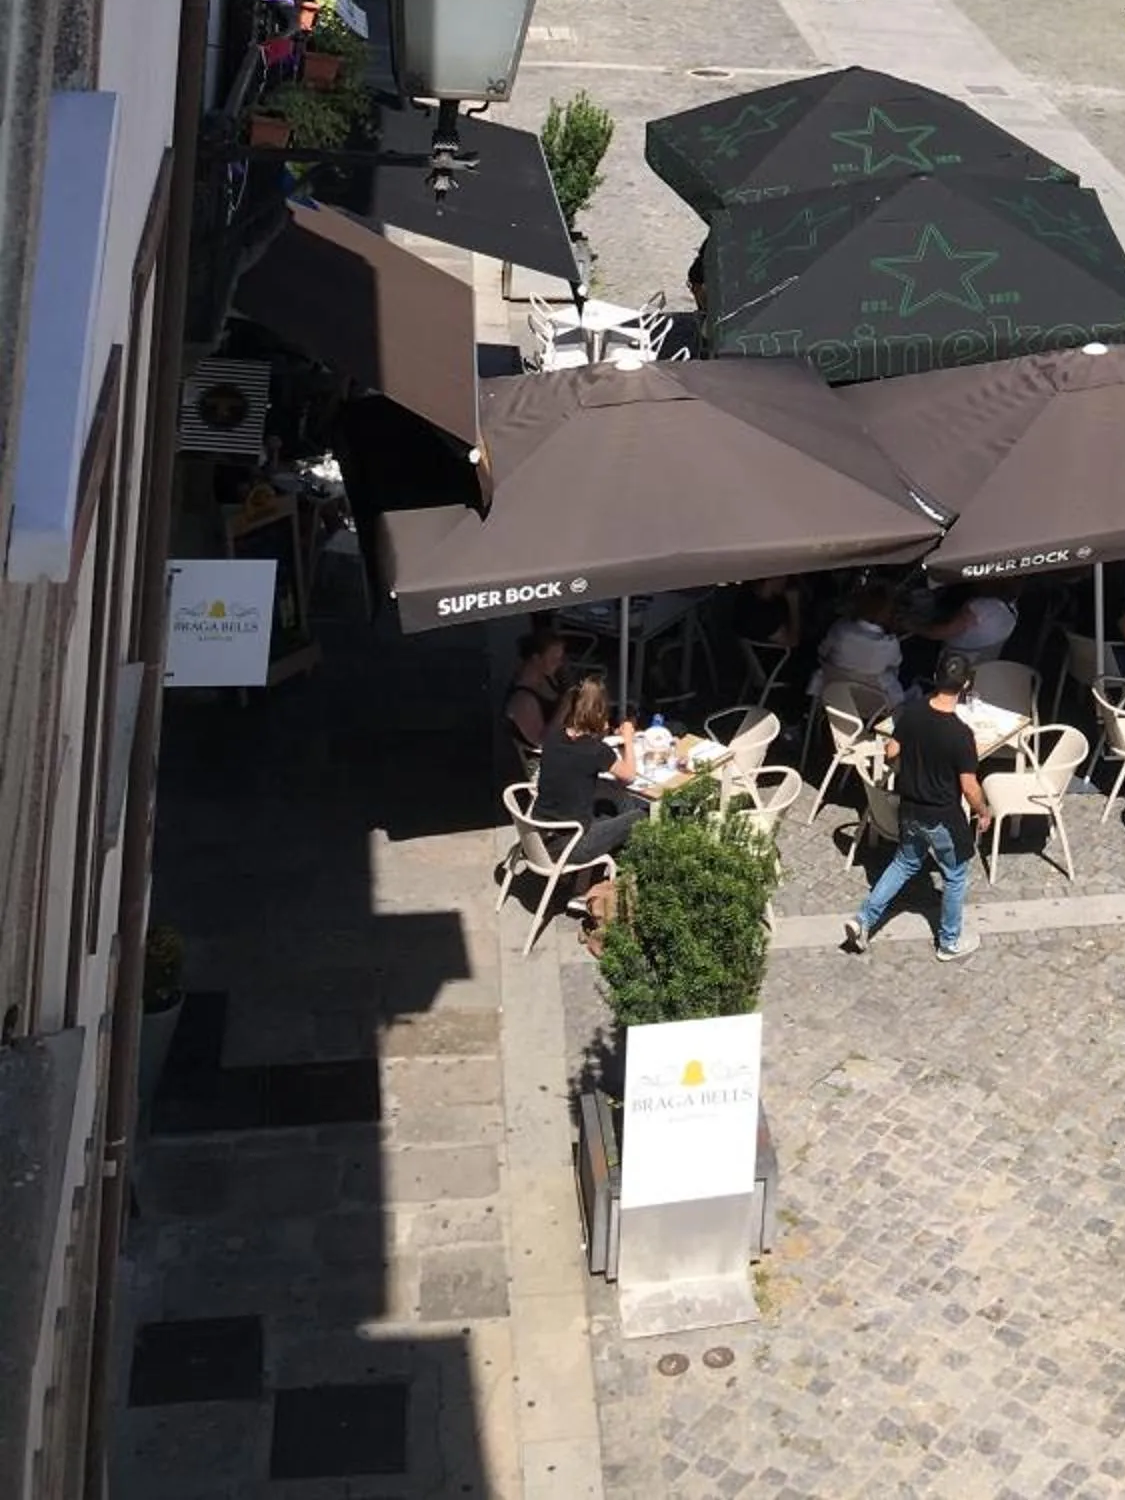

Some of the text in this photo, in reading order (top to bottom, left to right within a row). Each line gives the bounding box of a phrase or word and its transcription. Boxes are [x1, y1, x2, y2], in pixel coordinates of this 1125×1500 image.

[961, 549, 1070, 578] SUPER BOCK
[437, 580, 563, 616] SUPER BOCK
[631, 1093, 695, 1114] BRAGA
